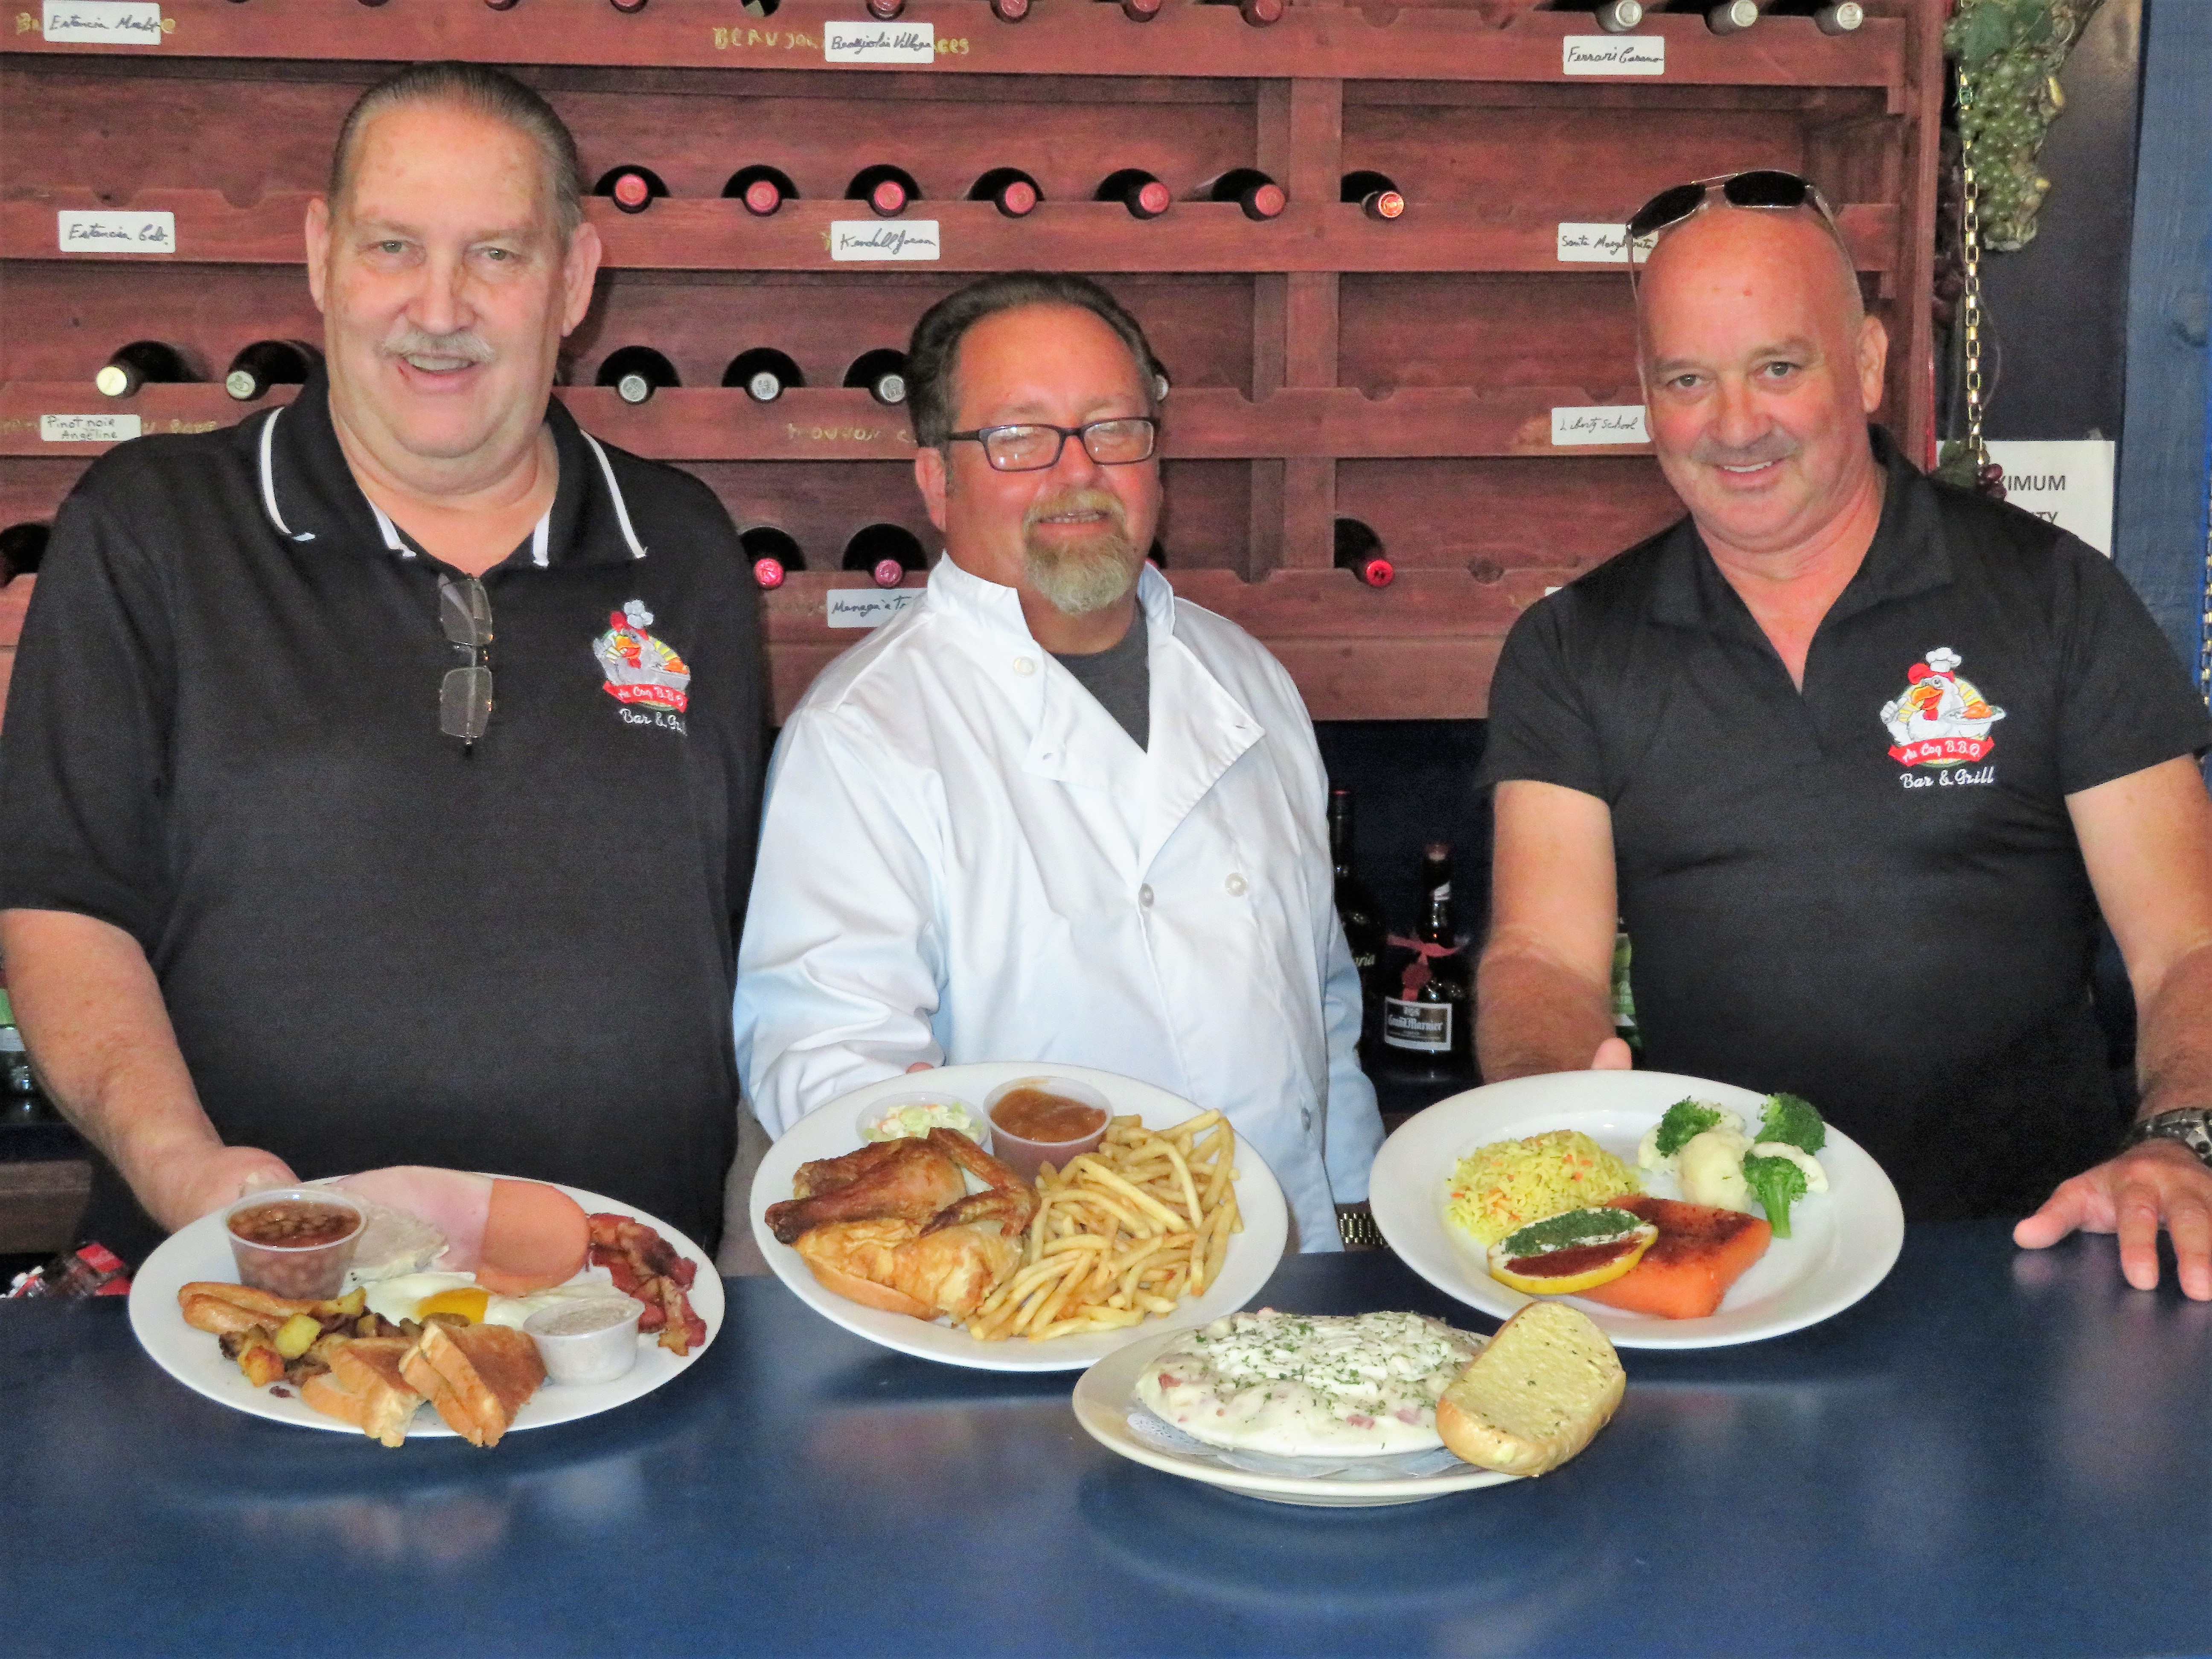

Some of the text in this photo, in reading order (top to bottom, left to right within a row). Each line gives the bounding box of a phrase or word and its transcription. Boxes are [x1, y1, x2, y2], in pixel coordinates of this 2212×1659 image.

[618, 708, 652, 724] Bar
[1921, 742, 1942, 757] Coq
[1899, 765, 1995, 789] Bar & Grill
